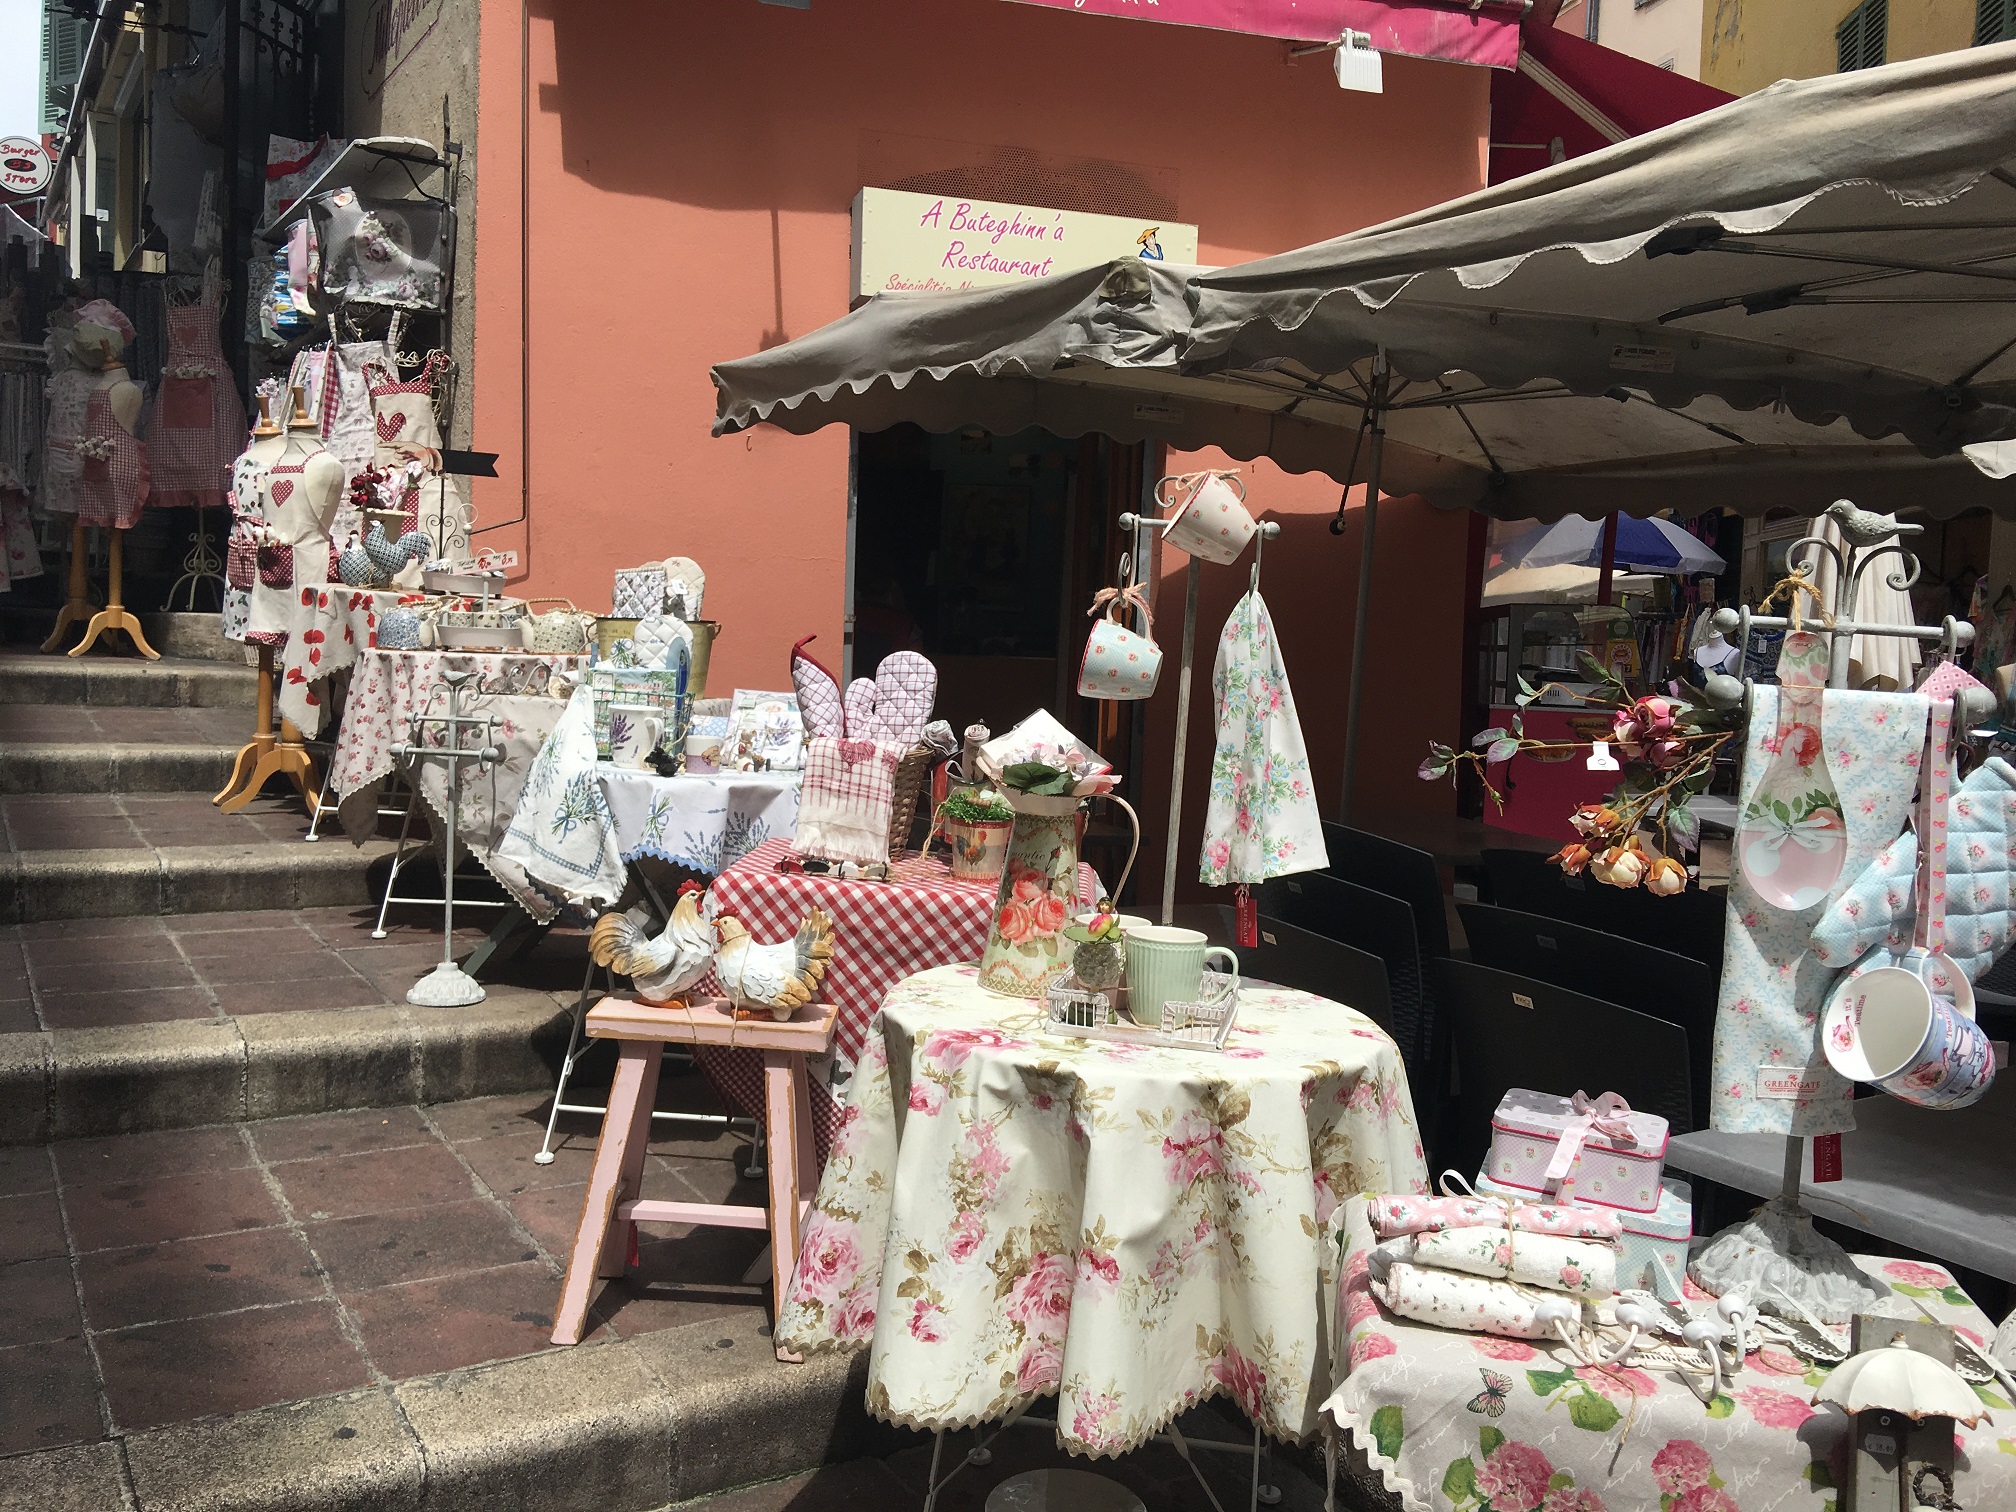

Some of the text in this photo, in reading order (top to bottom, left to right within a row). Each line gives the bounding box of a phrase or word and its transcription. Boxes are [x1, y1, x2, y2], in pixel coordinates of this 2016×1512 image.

[0, 145, 40, 157] Burger
[922, 200, 943, 228] A
[942, 240, 1053, 278] Restaurant
[1854, 994, 1867, 1026] Teatime
[1764, 1080, 1821, 1089] GREENGATE
